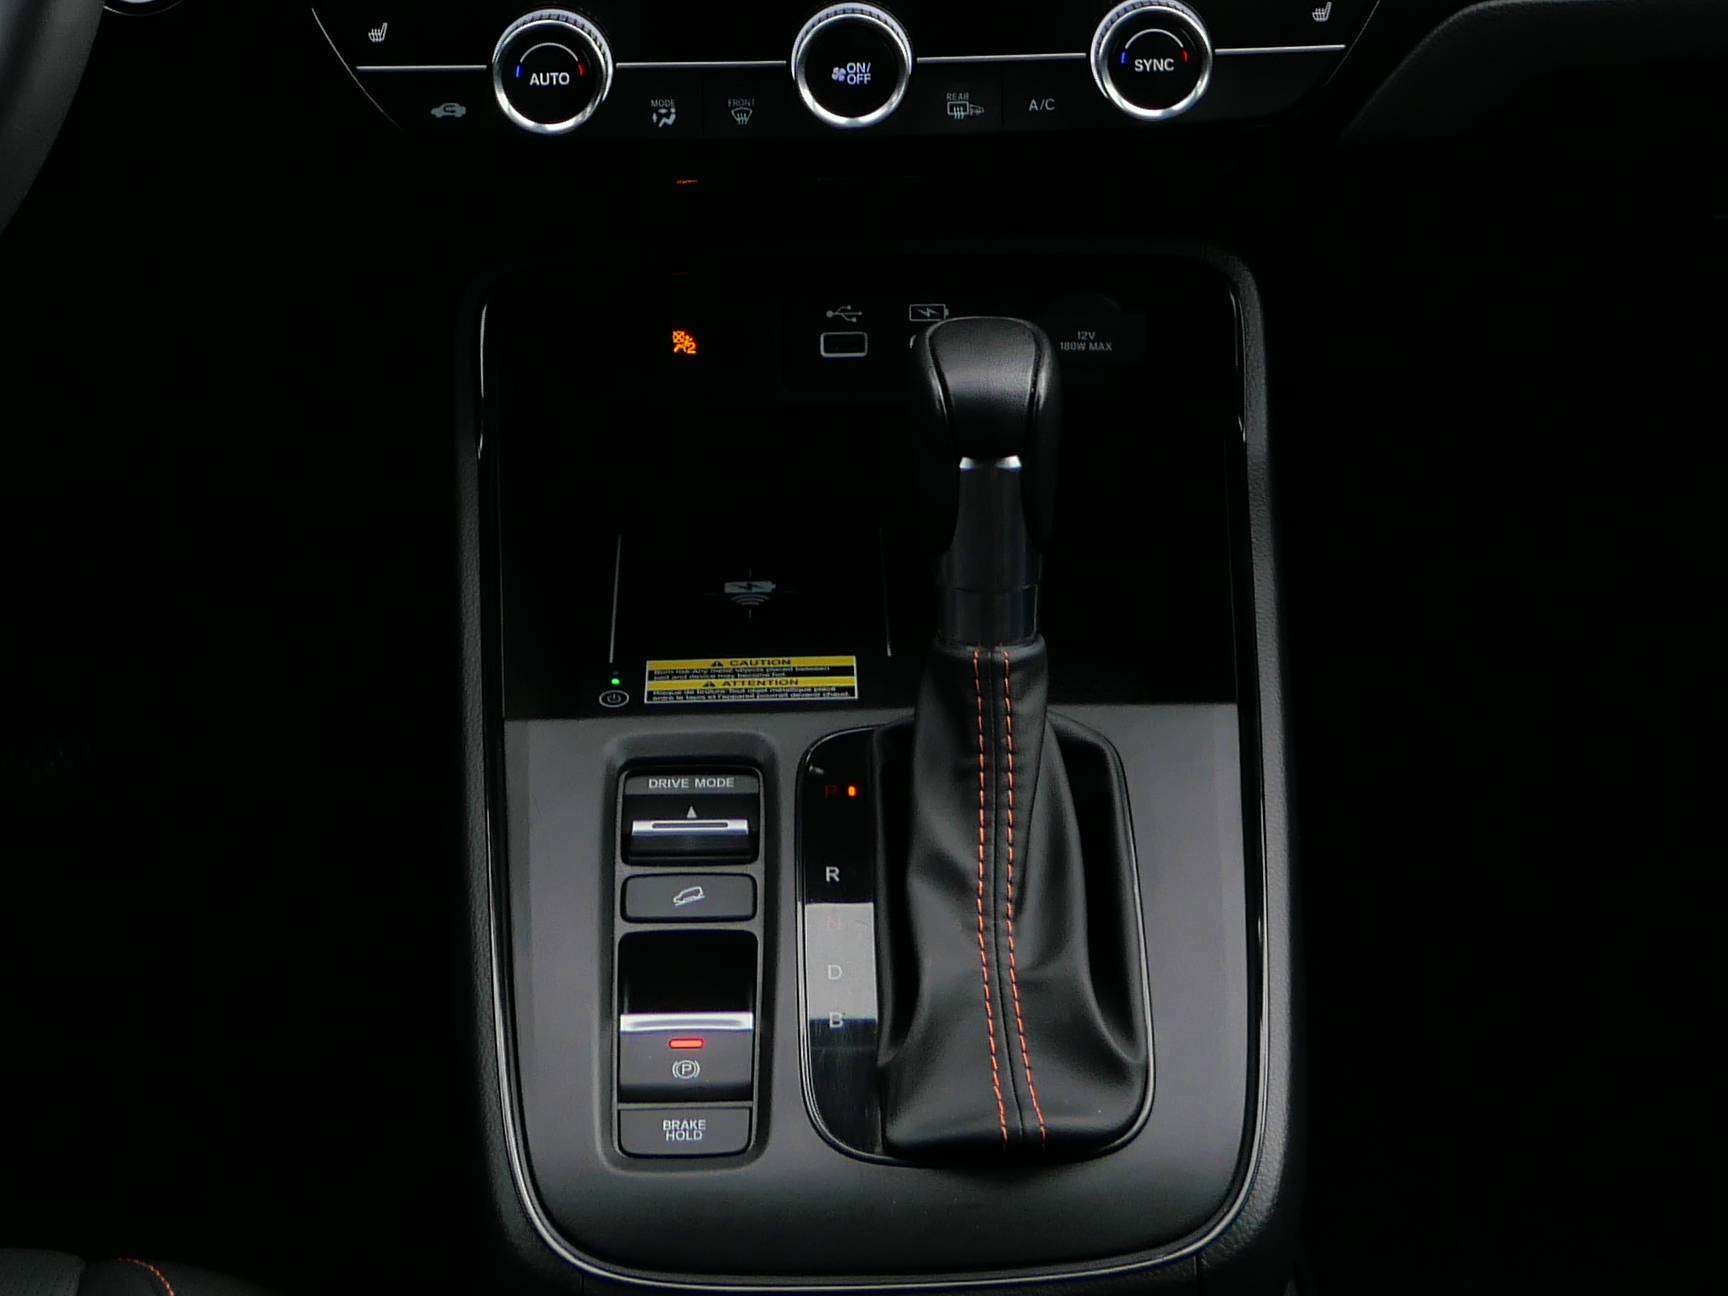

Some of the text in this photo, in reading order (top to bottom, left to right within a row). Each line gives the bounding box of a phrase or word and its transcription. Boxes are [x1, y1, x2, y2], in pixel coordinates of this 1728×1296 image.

[846, 61, 872, 75] ON/
[1133, 57, 1175, 74] SYNC
[528, 72, 571, 87] AUTO
[845, 73, 873, 86] OFF
[1027, 97, 1057, 113] A/C
[729, 659, 792, 667] CAUTION
[722, 679, 800, 687] ATTENTION
[648, 776, 736, 790] DRIVE MODE
[825, 865, 841, 883] R
[827, 964, 843, 980] D
[662, 1118, 707, 1132] BRAKE
[665, 1129, 704, 1142] HOLD
